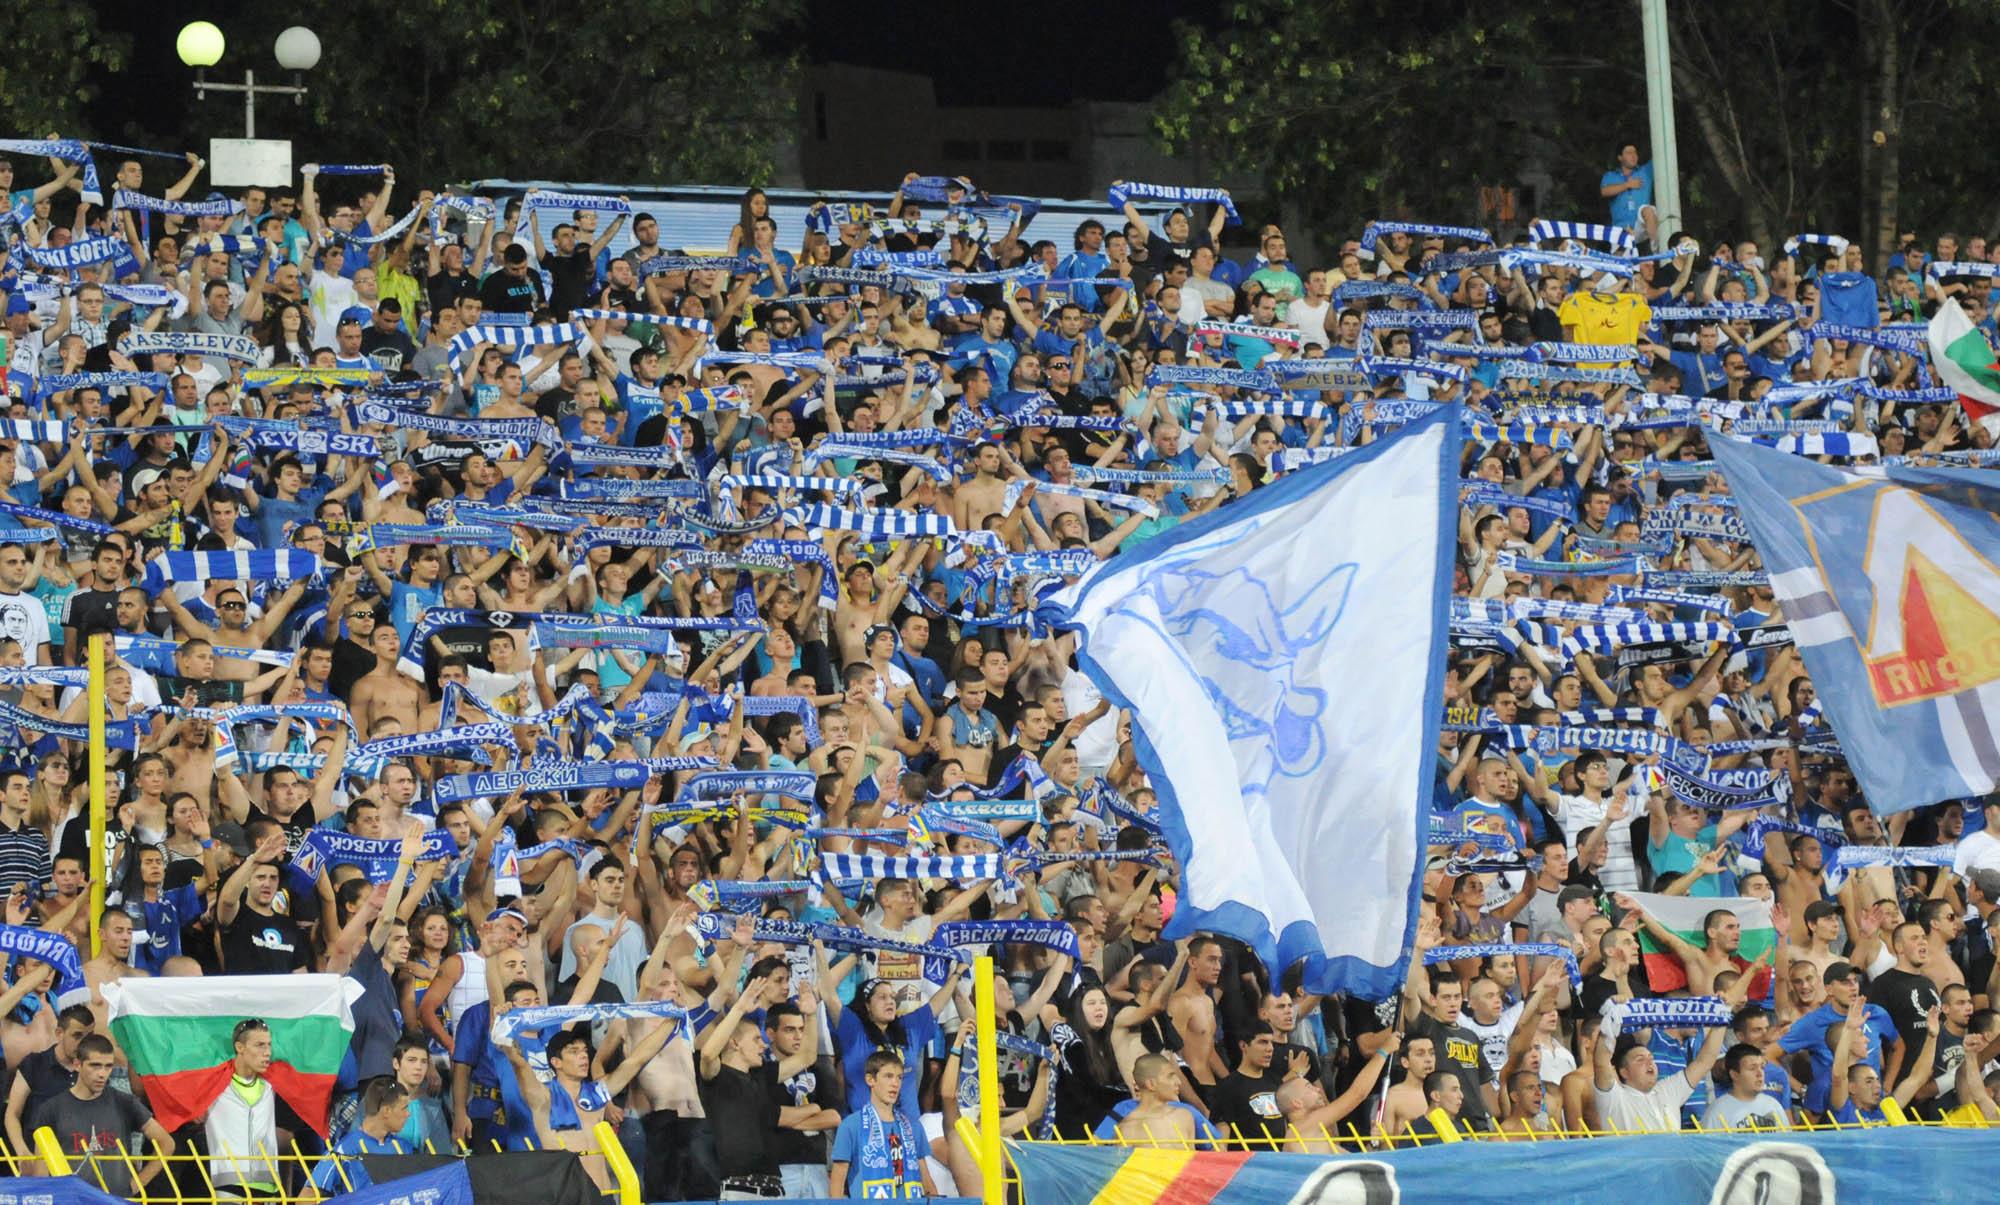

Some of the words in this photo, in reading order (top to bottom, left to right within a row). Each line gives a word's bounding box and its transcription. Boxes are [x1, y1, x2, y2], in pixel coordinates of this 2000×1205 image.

[400, 413, 450, 431] ЛЕВСКИ
[489, 422, 537, 436] СОФИЯ
[474, 767, 580, 793] ЛЕВСКИ
[1011, 927, 1075, 950] СОФИЯ
